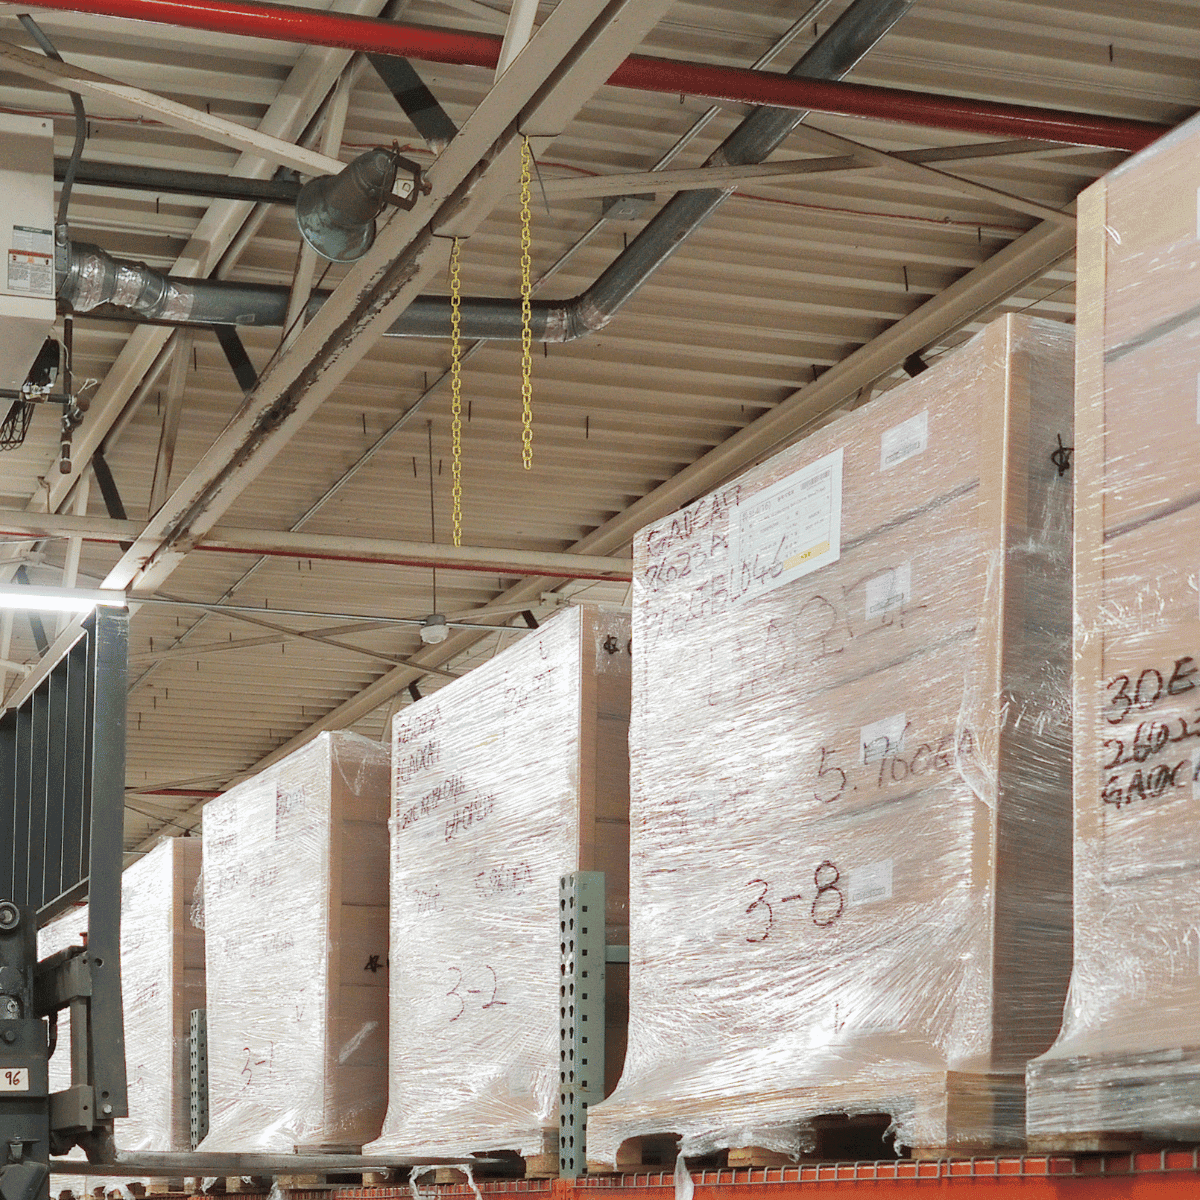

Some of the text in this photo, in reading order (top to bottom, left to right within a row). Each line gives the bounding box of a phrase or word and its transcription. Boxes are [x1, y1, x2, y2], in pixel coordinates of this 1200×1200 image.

[745, 859, 845, 944] 3-8
[445, 964, 508, 1022] 3-2
[5, 1071, 21, 1086] 96
